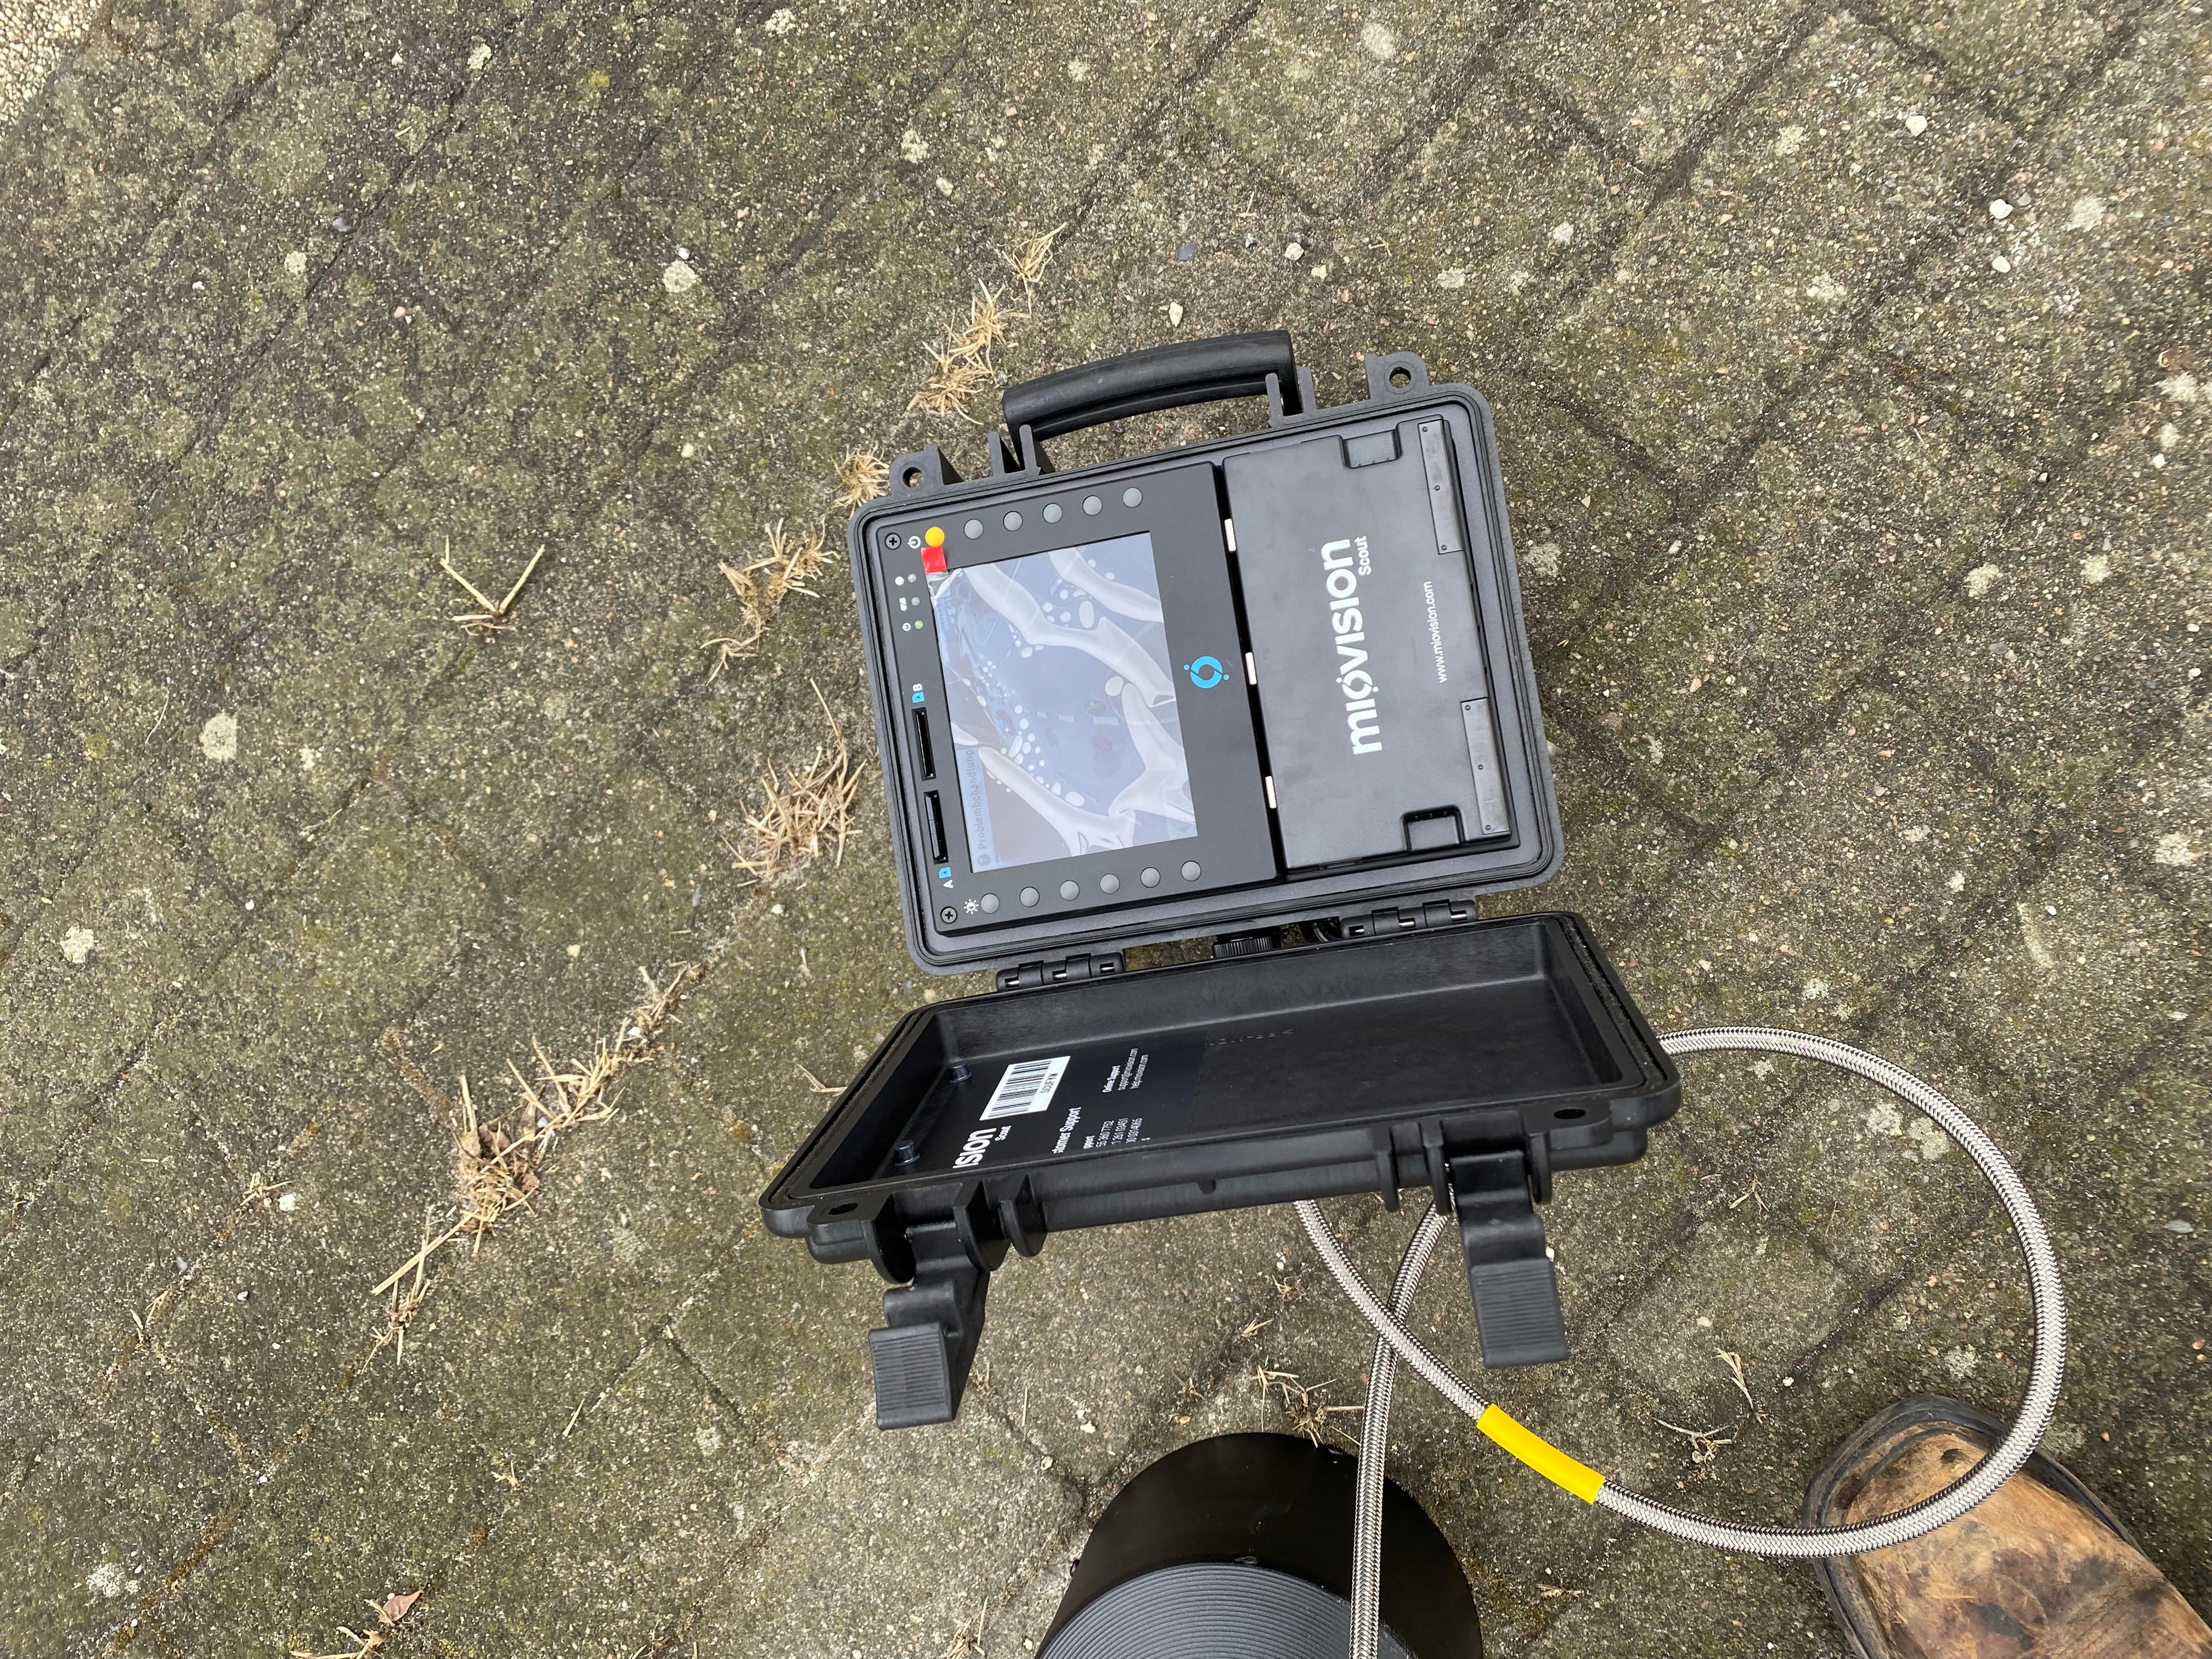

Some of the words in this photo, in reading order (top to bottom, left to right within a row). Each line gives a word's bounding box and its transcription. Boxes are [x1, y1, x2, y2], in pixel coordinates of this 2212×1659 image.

[1354, 535, 1372, 576] Scout
[1424, 580, 1448, 684] www.miovision.com
[1321, 539, 1383, 755] miovision
[912, 683, 923, 692] B
[967, 749, 988, 850] Problembehandlung
[943, 879, 953, 888] A
[1107, 1065, 1121, 1081] Support
[1102, 1079, 1115, 1093] Online
[1059, 1107, 1081, 1132] Support
[995, 1125, 1012, 1141] Scout
